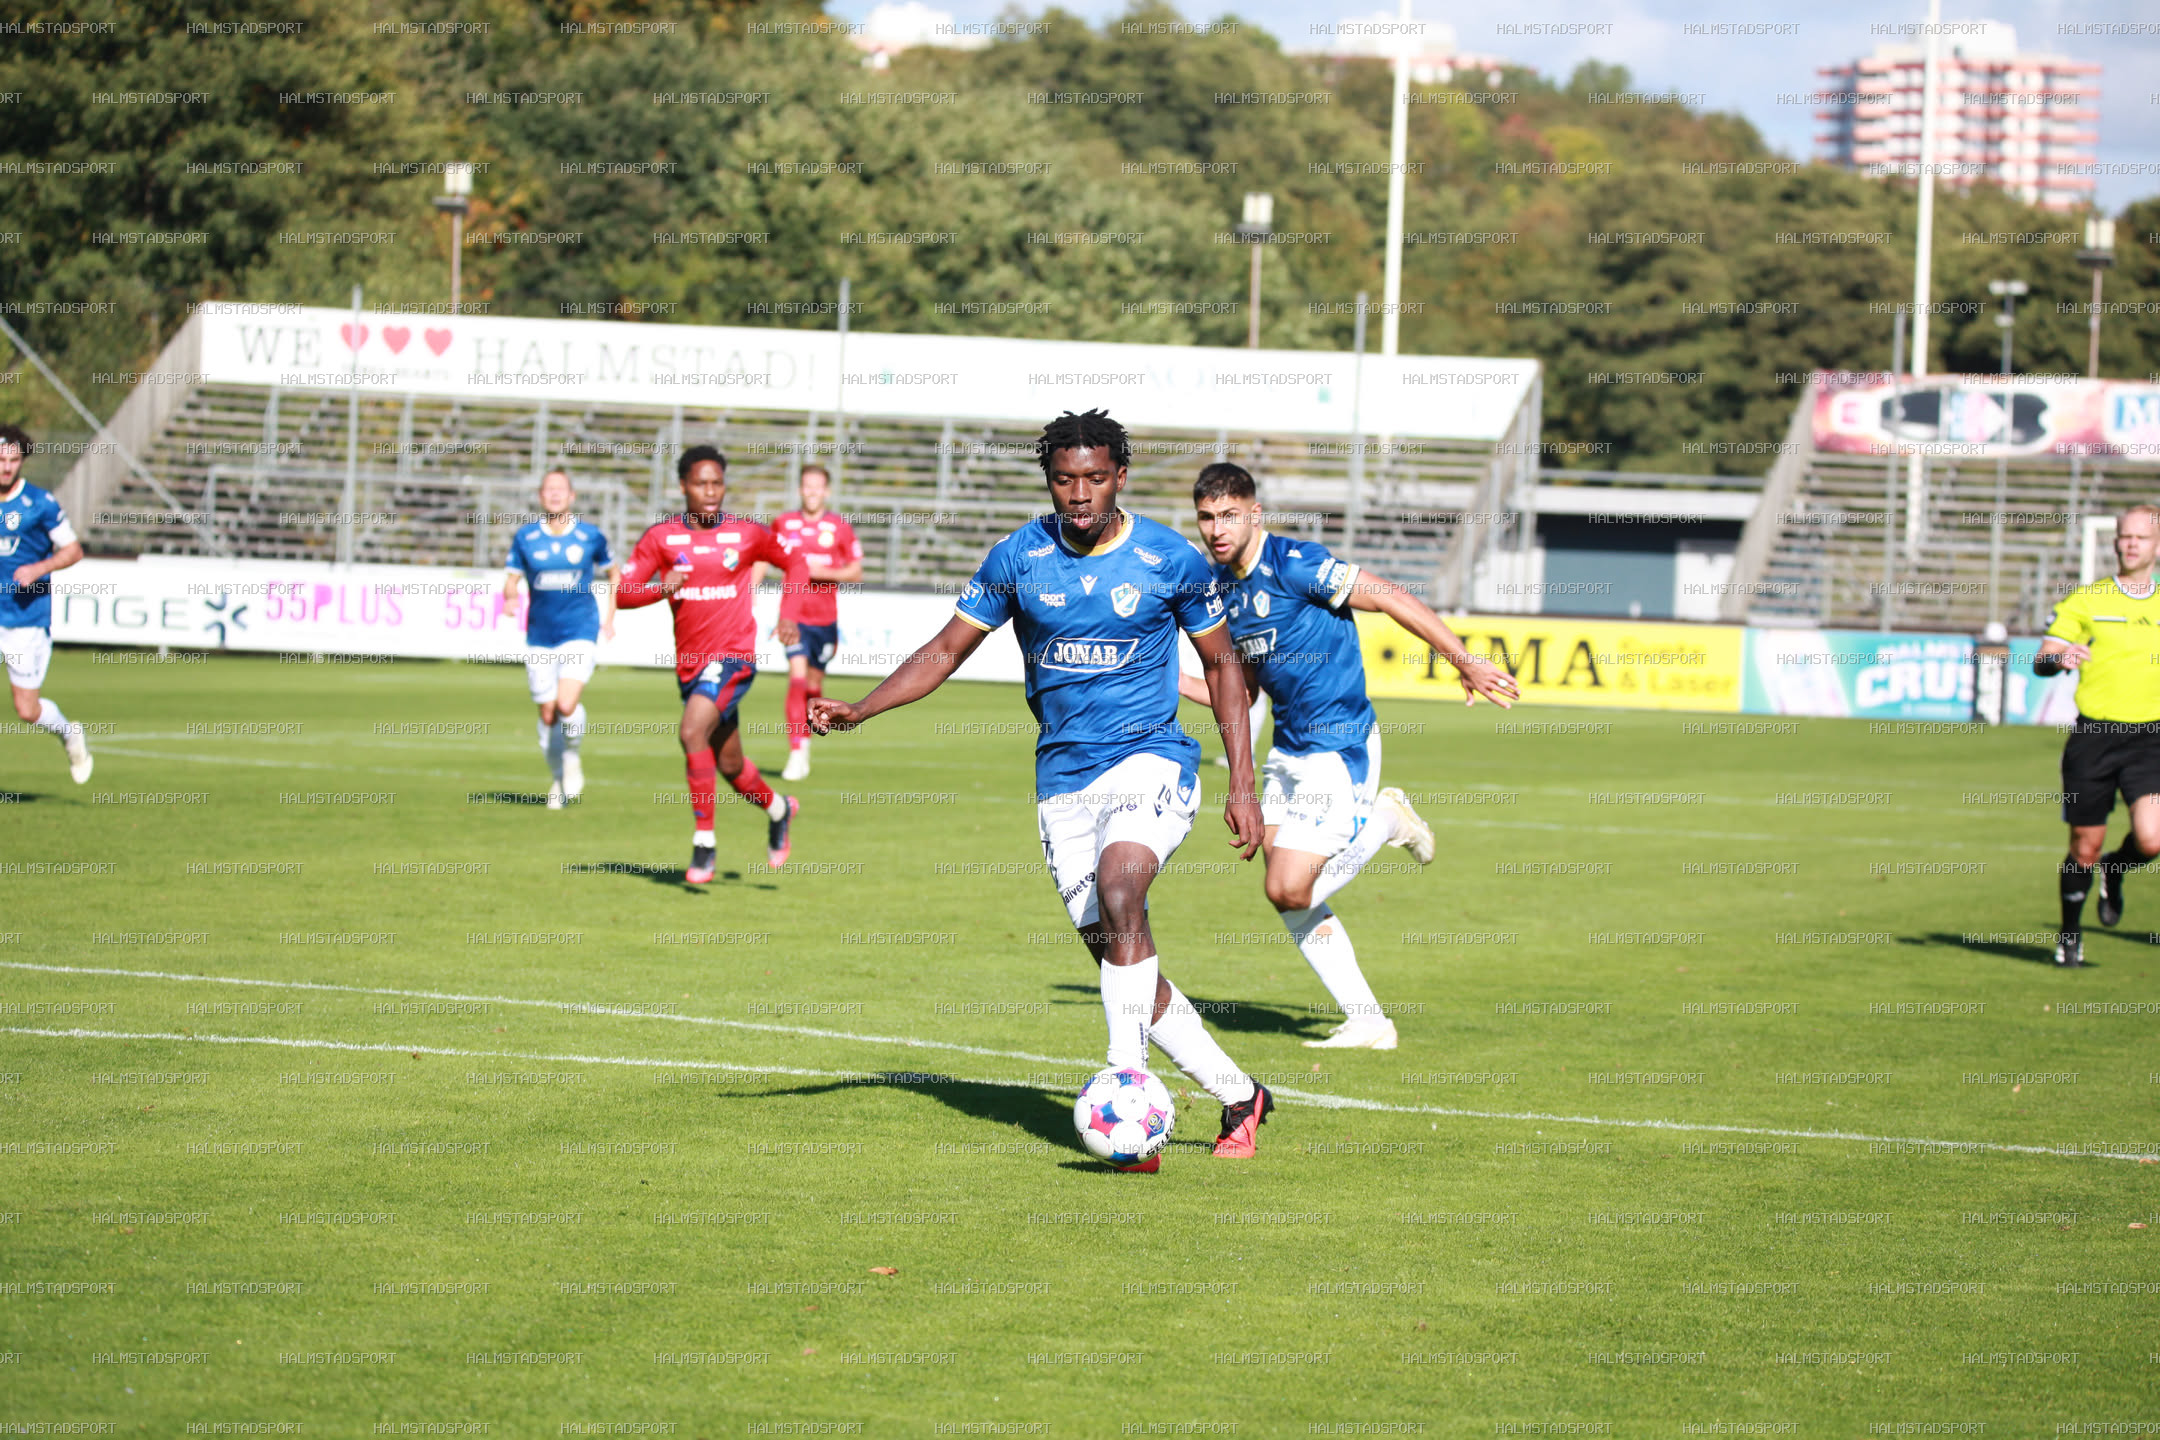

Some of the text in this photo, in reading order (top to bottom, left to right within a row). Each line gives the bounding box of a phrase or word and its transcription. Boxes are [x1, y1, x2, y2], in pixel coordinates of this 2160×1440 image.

[1039, 593, 1066, 604] sport
[1053, 641, 1118, 665] JONAB
[1146, 1113, 1175, 1157] SELEC
